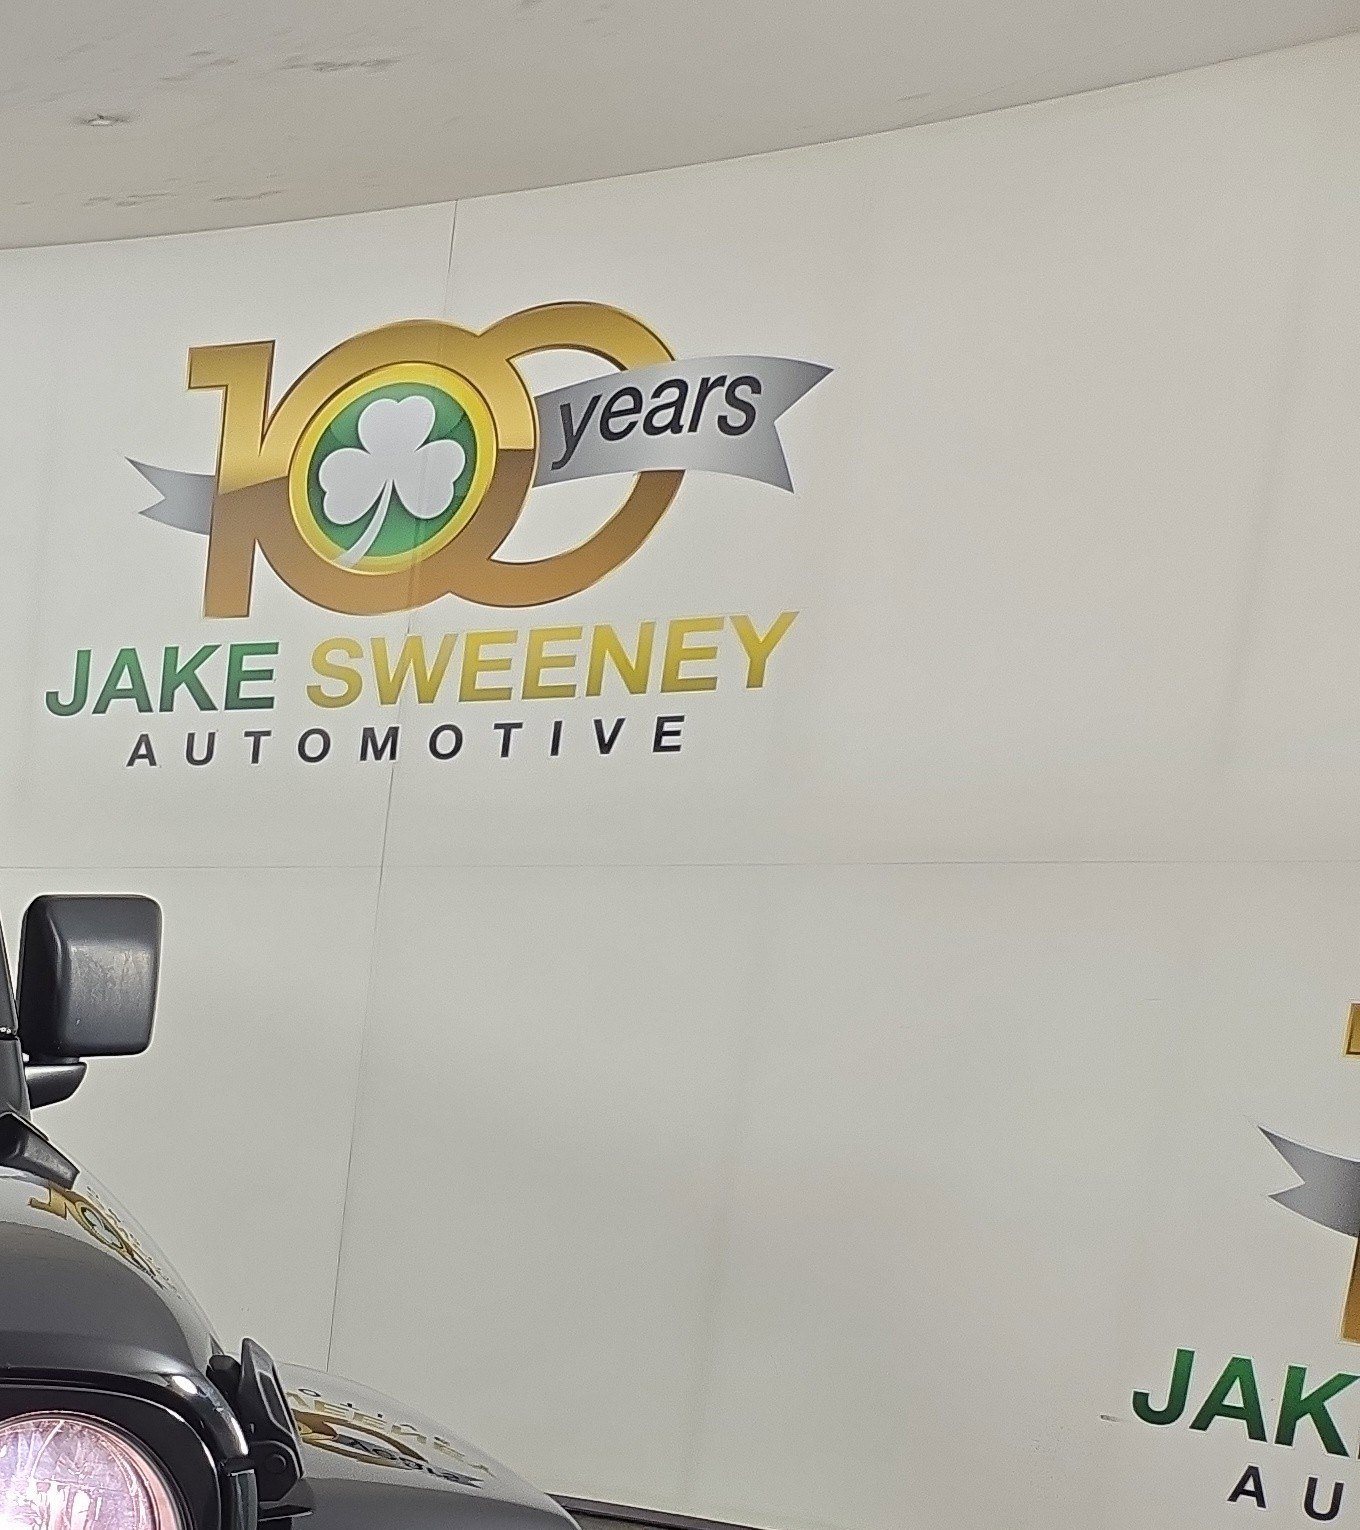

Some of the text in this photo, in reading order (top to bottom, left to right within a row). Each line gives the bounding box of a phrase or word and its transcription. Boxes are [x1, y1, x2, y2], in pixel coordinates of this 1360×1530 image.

[550, 372, 762, 472] years
[45, 611, 800, 717] JAKE SWEENEY
[126, 714, 685, 768] AUTOMOTIVE
[1132, 1349, 1360, 1459] JAK
